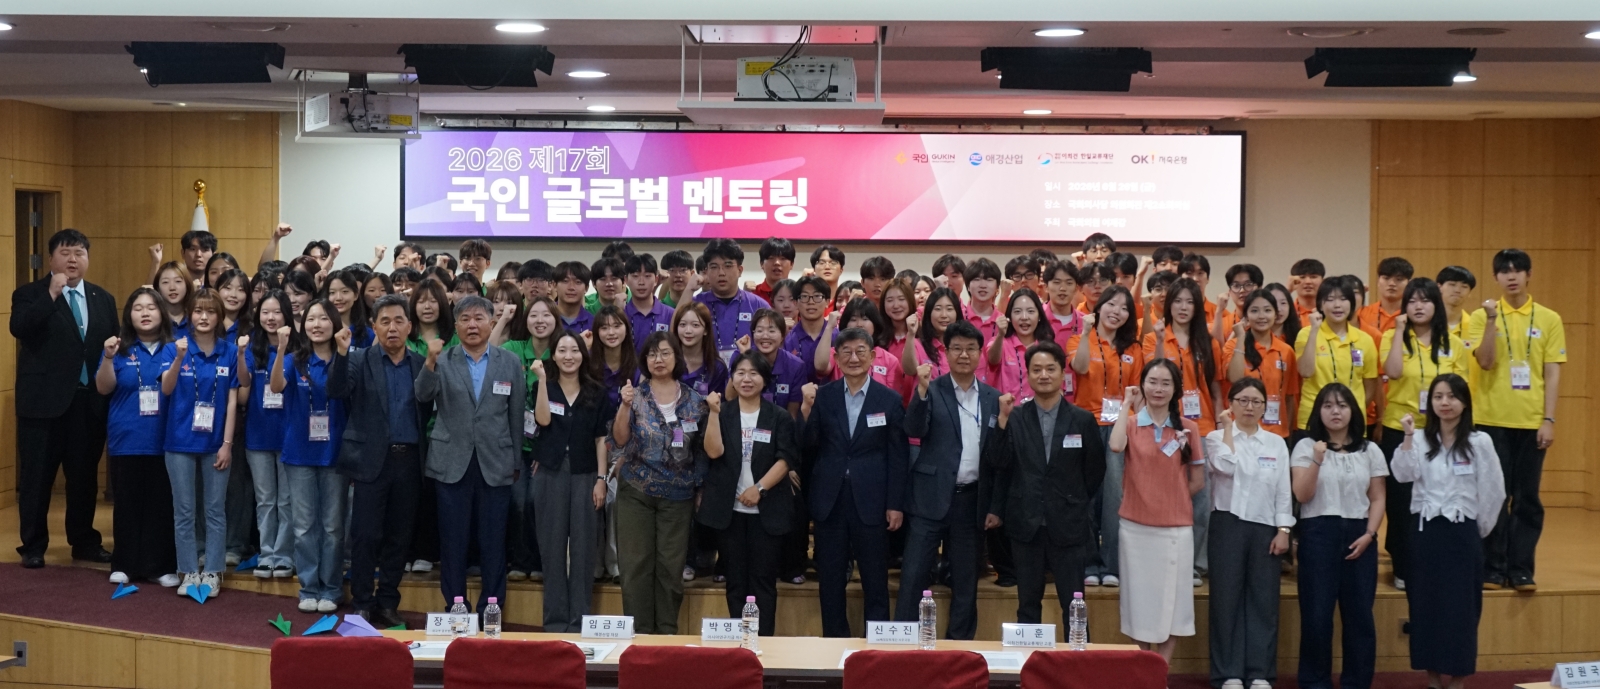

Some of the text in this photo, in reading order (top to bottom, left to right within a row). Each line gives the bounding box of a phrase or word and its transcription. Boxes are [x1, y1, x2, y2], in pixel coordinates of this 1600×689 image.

[448, 146, 610, 174] 2026 제17회
[911, 154, 929, 164] 국인
[985, 154, 1023, 165] 애경산업
[1044, 181, 1061, 192] 일시
[1068, 182, 1101, 192] 2026년
[446, 176, 808, 225] 국인 글로벌 멘토링
[1044, 199, 1061, 209] 장소
[1044, 217, 1061, 227] 주최
